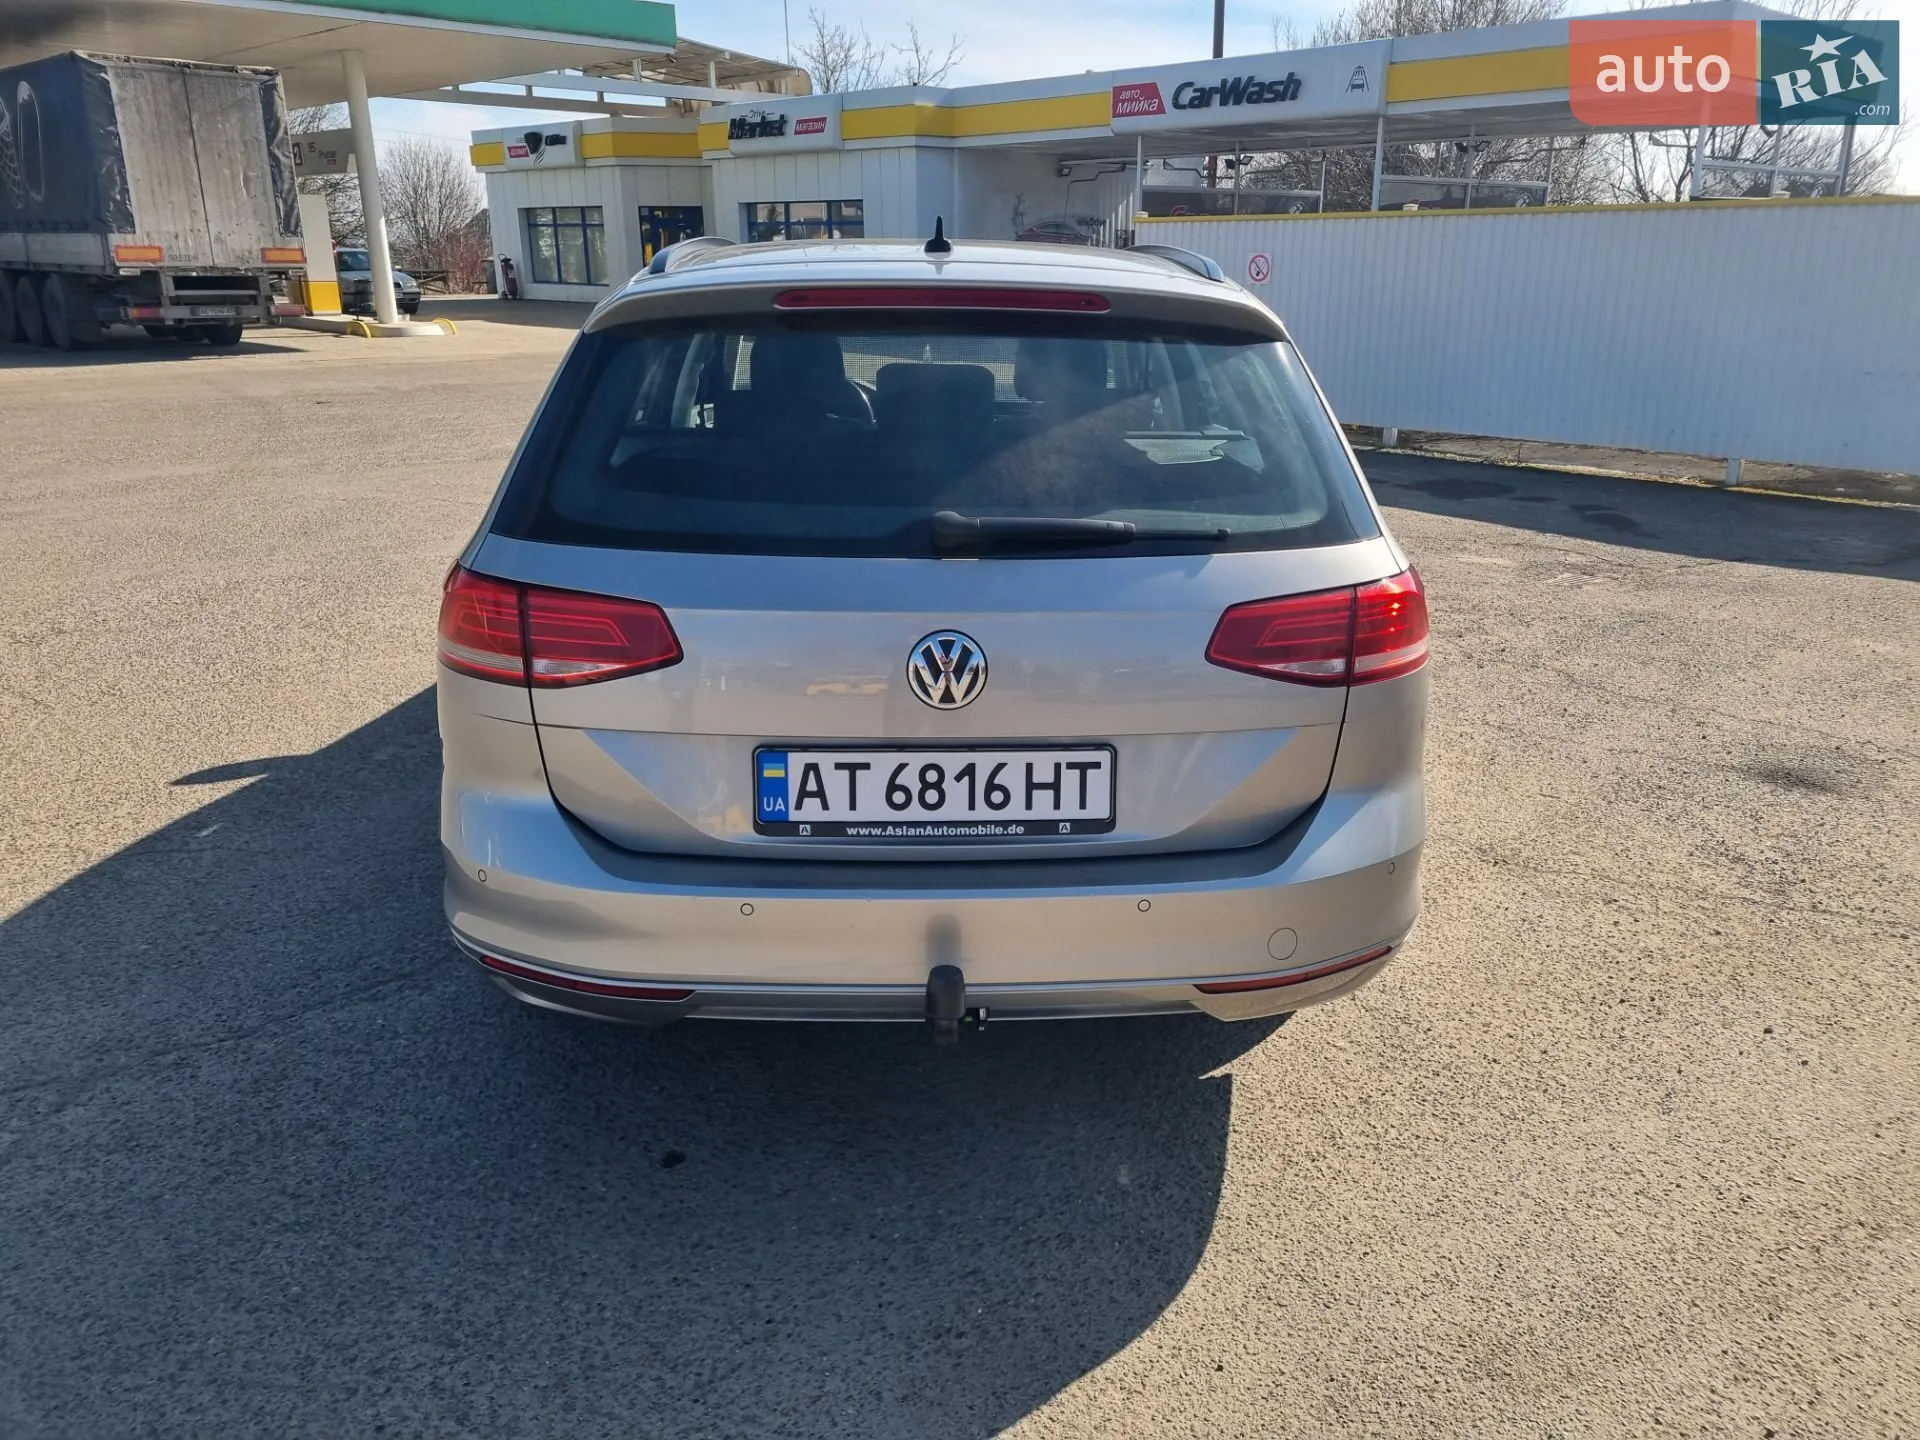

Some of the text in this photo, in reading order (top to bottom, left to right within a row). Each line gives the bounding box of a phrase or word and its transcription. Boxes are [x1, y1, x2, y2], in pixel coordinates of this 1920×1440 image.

[1171, 71, 1302, 110] CarWash
[763, 797, 786, 812] UA
[794, 761, 1102, 812] AT 6816 HT
